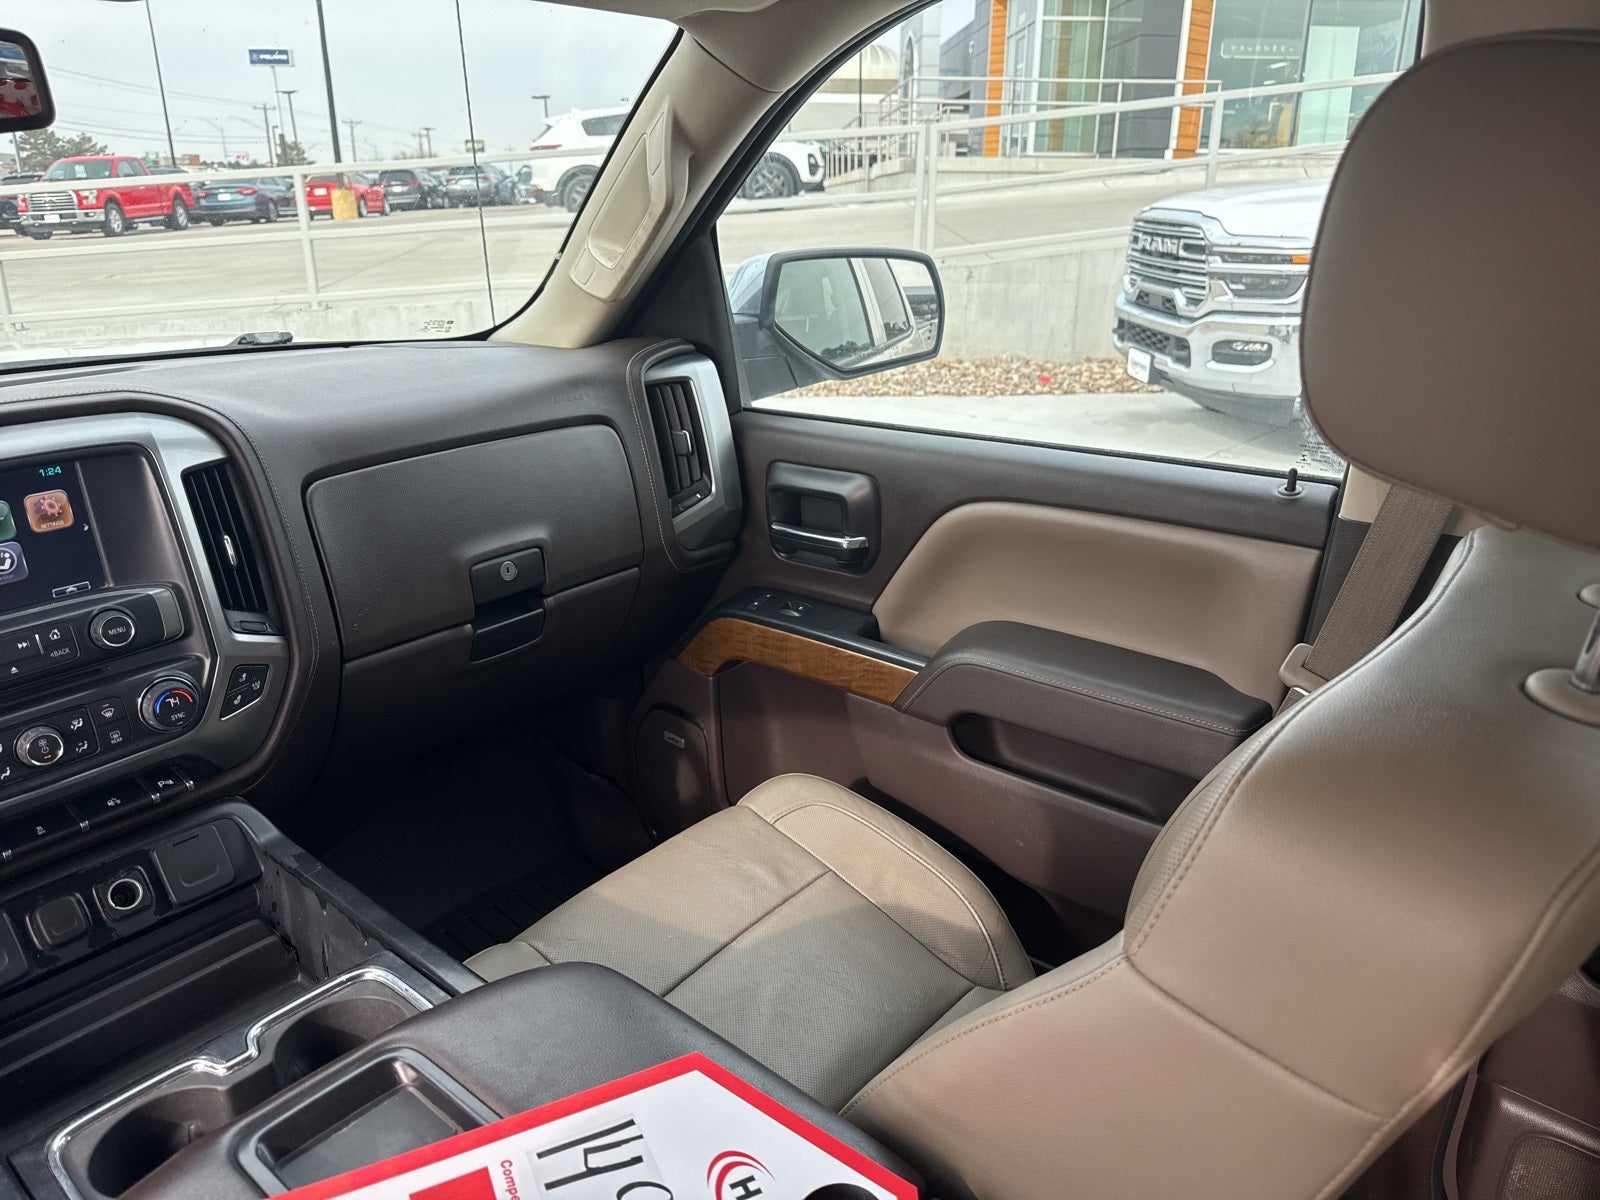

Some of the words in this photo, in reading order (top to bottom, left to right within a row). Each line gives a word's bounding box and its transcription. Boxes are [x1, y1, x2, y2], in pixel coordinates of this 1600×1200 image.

[1138, 233, 1179, 255] RAM
[39, 466, 62, 477] 1:24
[40, 520, 65, 529] SETTINGS
[108, 626, 127, 636] MENU
[53, 647, 71, 657] BACK
[165, 696, 180, 708] 74
[171, 711, 186, 721] SYNC
